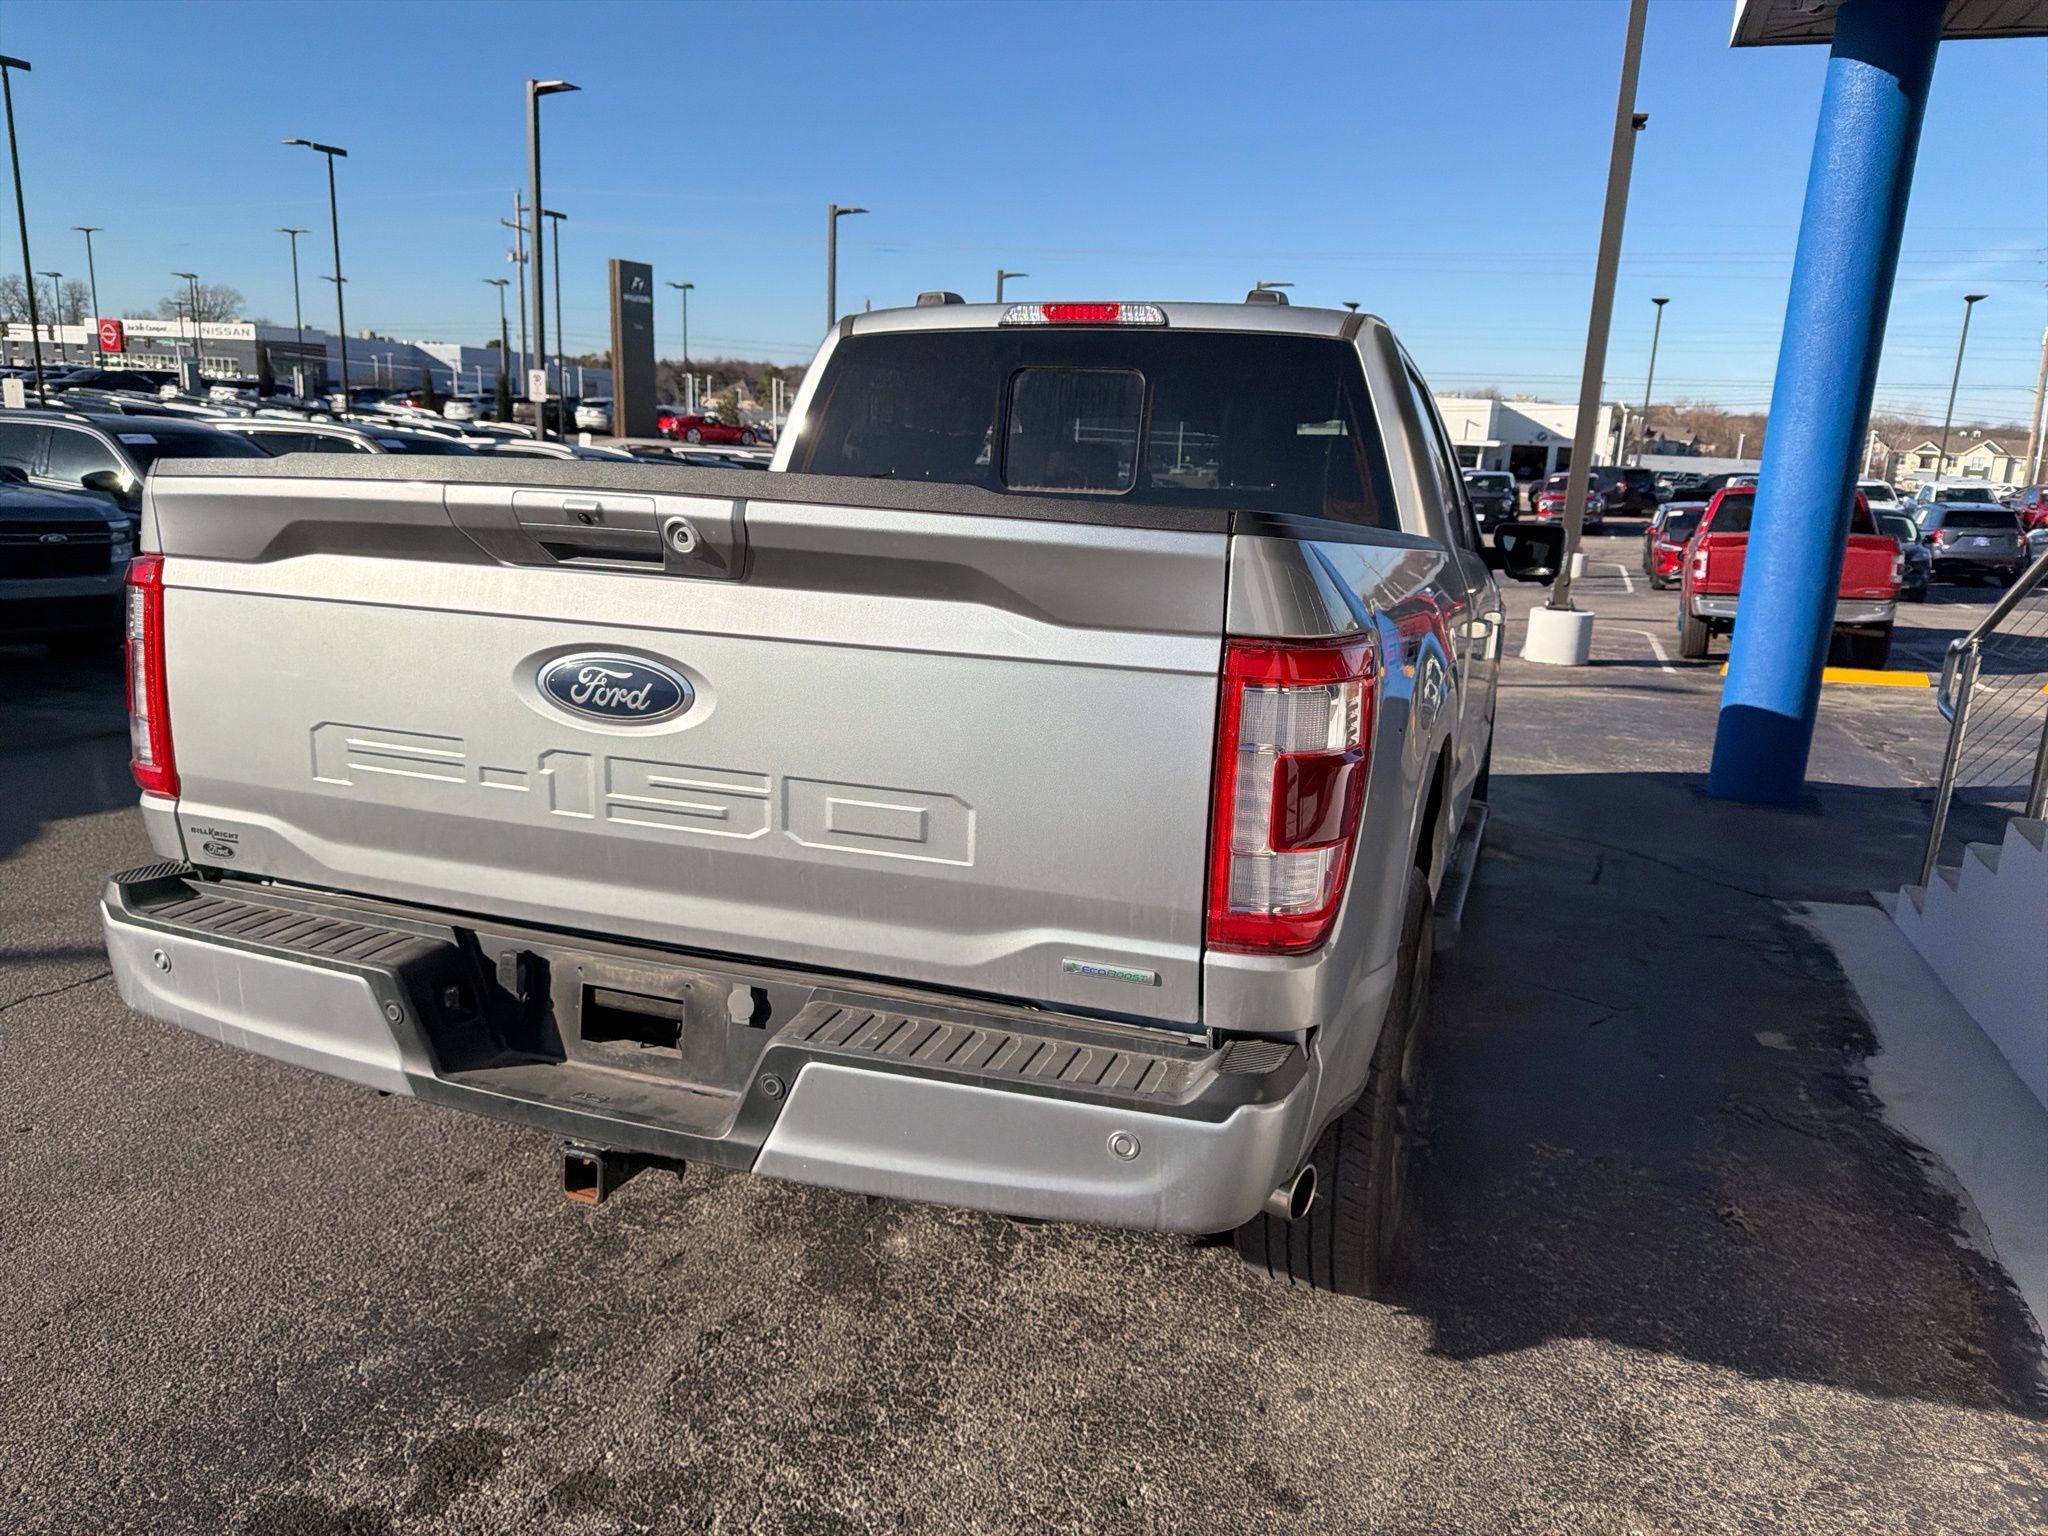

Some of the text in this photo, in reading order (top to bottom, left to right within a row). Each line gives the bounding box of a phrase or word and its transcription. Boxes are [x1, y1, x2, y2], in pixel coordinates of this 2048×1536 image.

[202, 326, 250, 336] NISSAN
[570, 666, 653, 711] Ford
[311, 721, 976, 866] F-150
